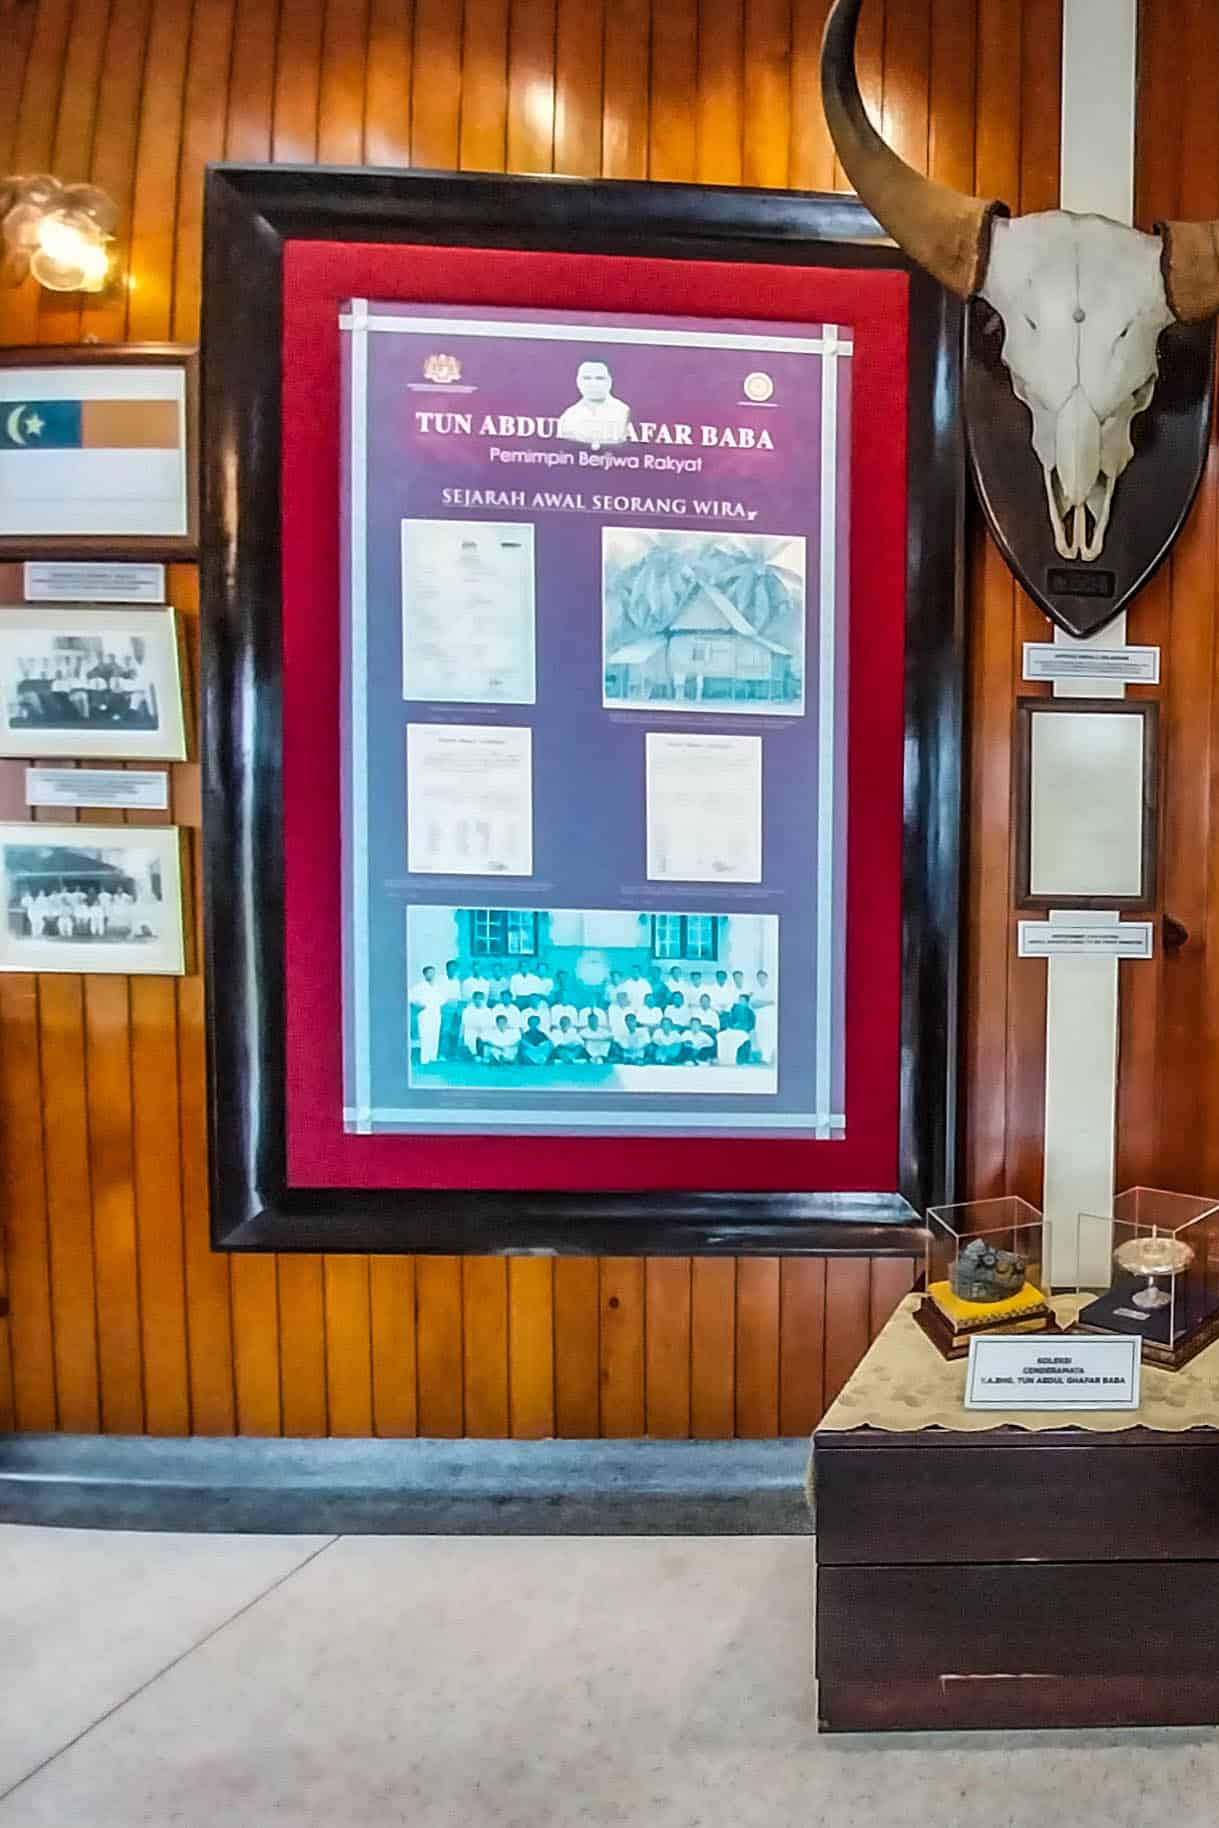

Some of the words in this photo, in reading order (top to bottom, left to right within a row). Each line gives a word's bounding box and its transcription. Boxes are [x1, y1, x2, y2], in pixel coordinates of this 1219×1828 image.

[415, 411, 473, 434] TUN
[700, 424, 774, 450] BABA
[489, 447, 574, 467] Pemimpin
[578, 451, 640, 470] Berjiwa
[643, 454, 703, 474] Rakyat
[441, 487, 526, 507] SEJARAH
[531, 491, 586, 509] AWAL
[591, 494, 687, 514] SEORANG
